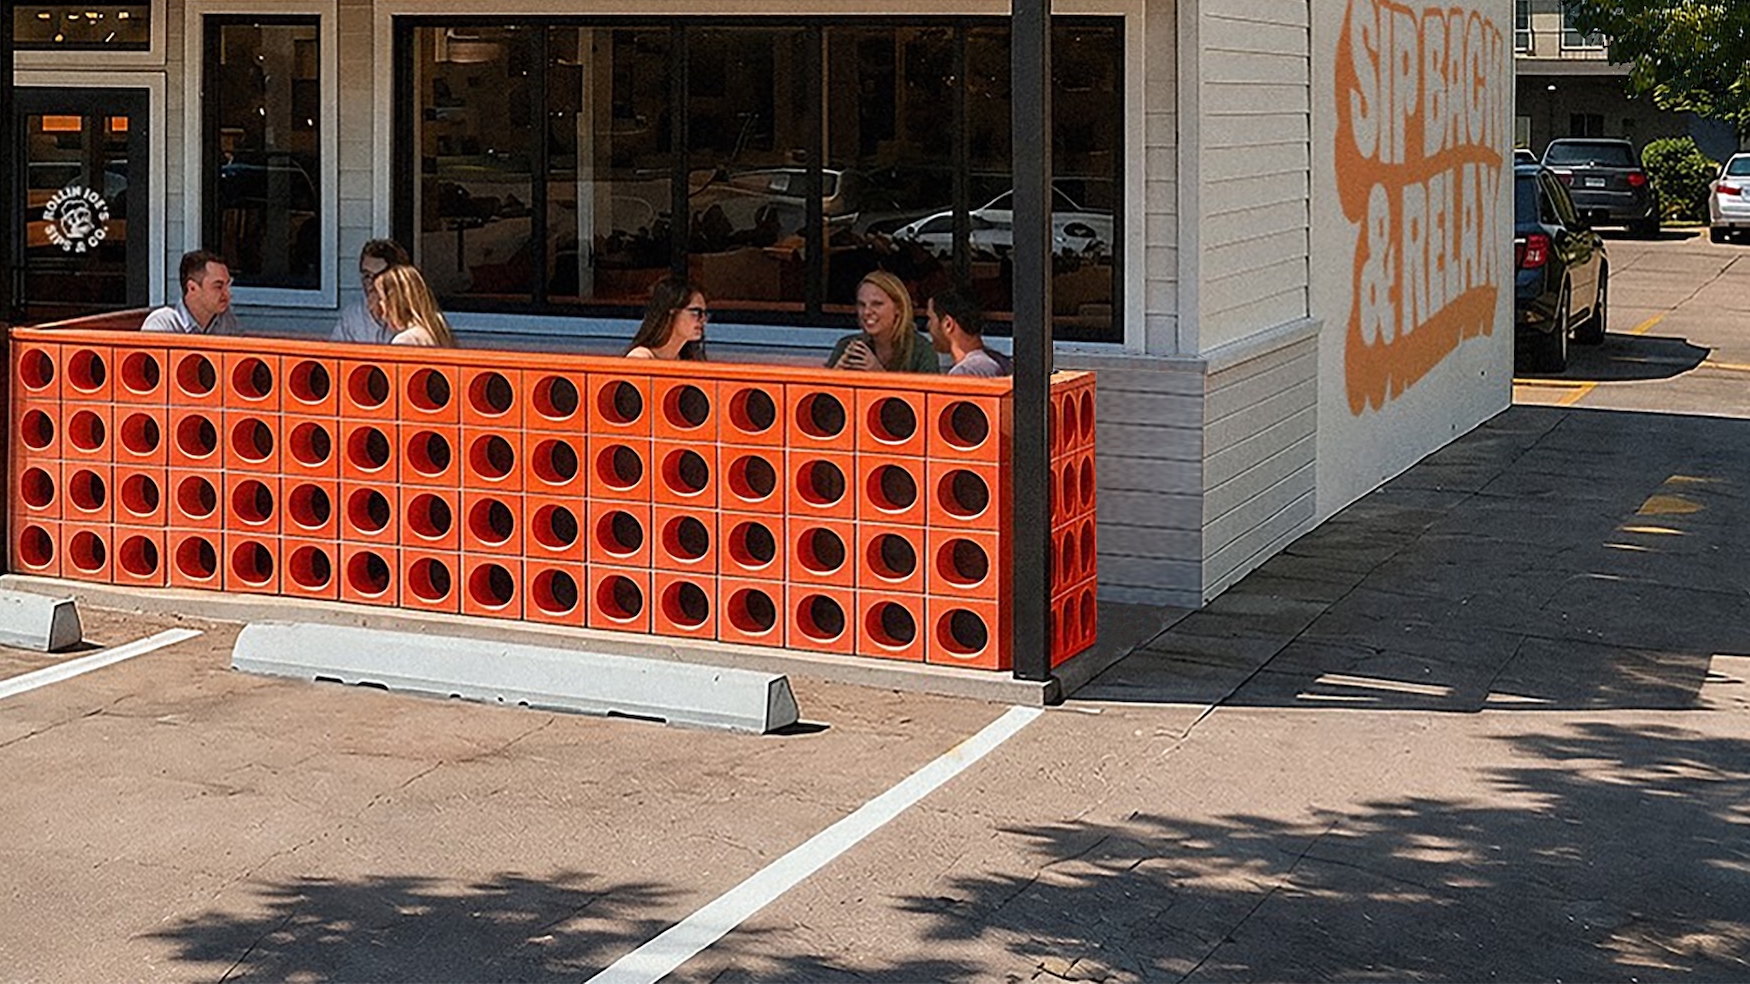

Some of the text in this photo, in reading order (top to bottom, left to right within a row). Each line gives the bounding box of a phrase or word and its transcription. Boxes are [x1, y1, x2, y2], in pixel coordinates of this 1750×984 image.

[42, 186, 82, 221] ROLLIN
[44, 224, 72, 252] SIPS
[1359, 161, 1499, 349] & RELAX
